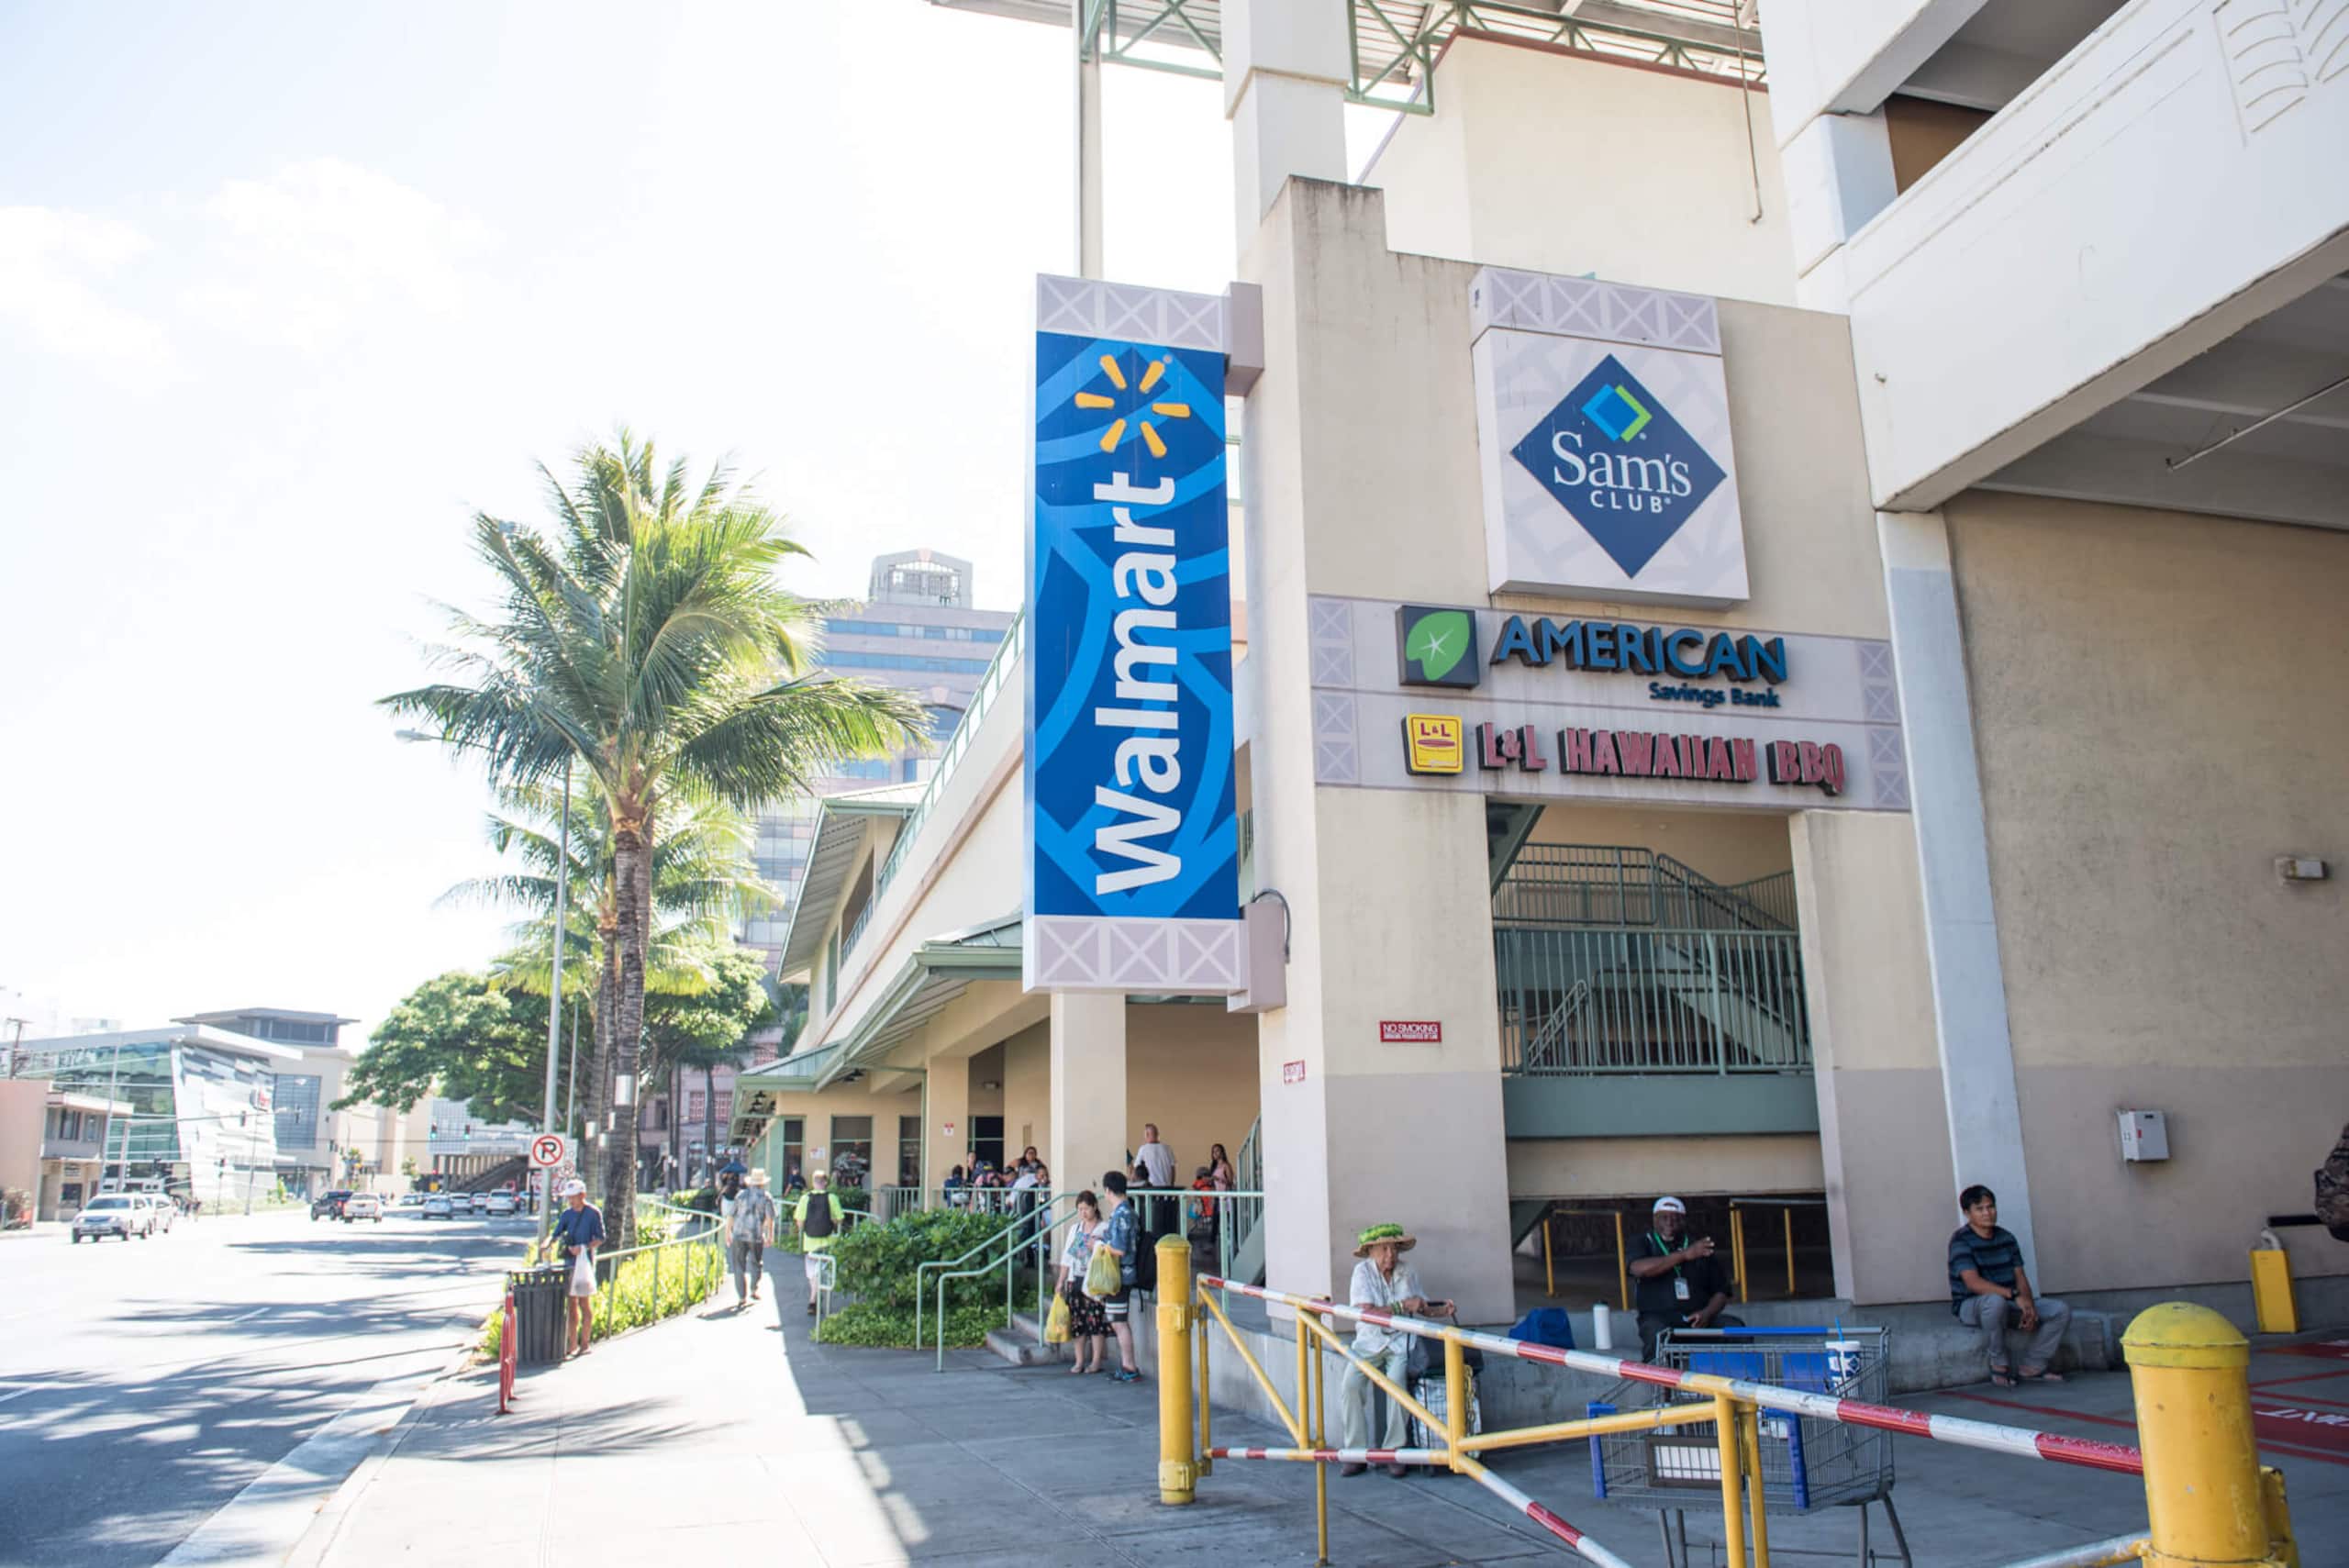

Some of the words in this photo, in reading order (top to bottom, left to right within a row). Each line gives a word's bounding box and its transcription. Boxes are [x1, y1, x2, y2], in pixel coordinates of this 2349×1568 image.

[1551, 430, 1692, 497] Sam's
[1494, 615, 1787, 684] AMERICAN
[1093, 471, 1182, 896] Walmart
[1649, 682, 1725, 708] Savings
[1731, 687, 1781, 708] Bank
[1419, 722, 1452, 738] L&L
[1479, 721, 1548, 769] L&L
[1562, 727, 1758, 781] HAWAIIAN
[1771, 740, 1845, 795] BBQ
[1383, 1023, 1397, 1034] NO
[1397, 1023, 1439, 1035] SMOKING
